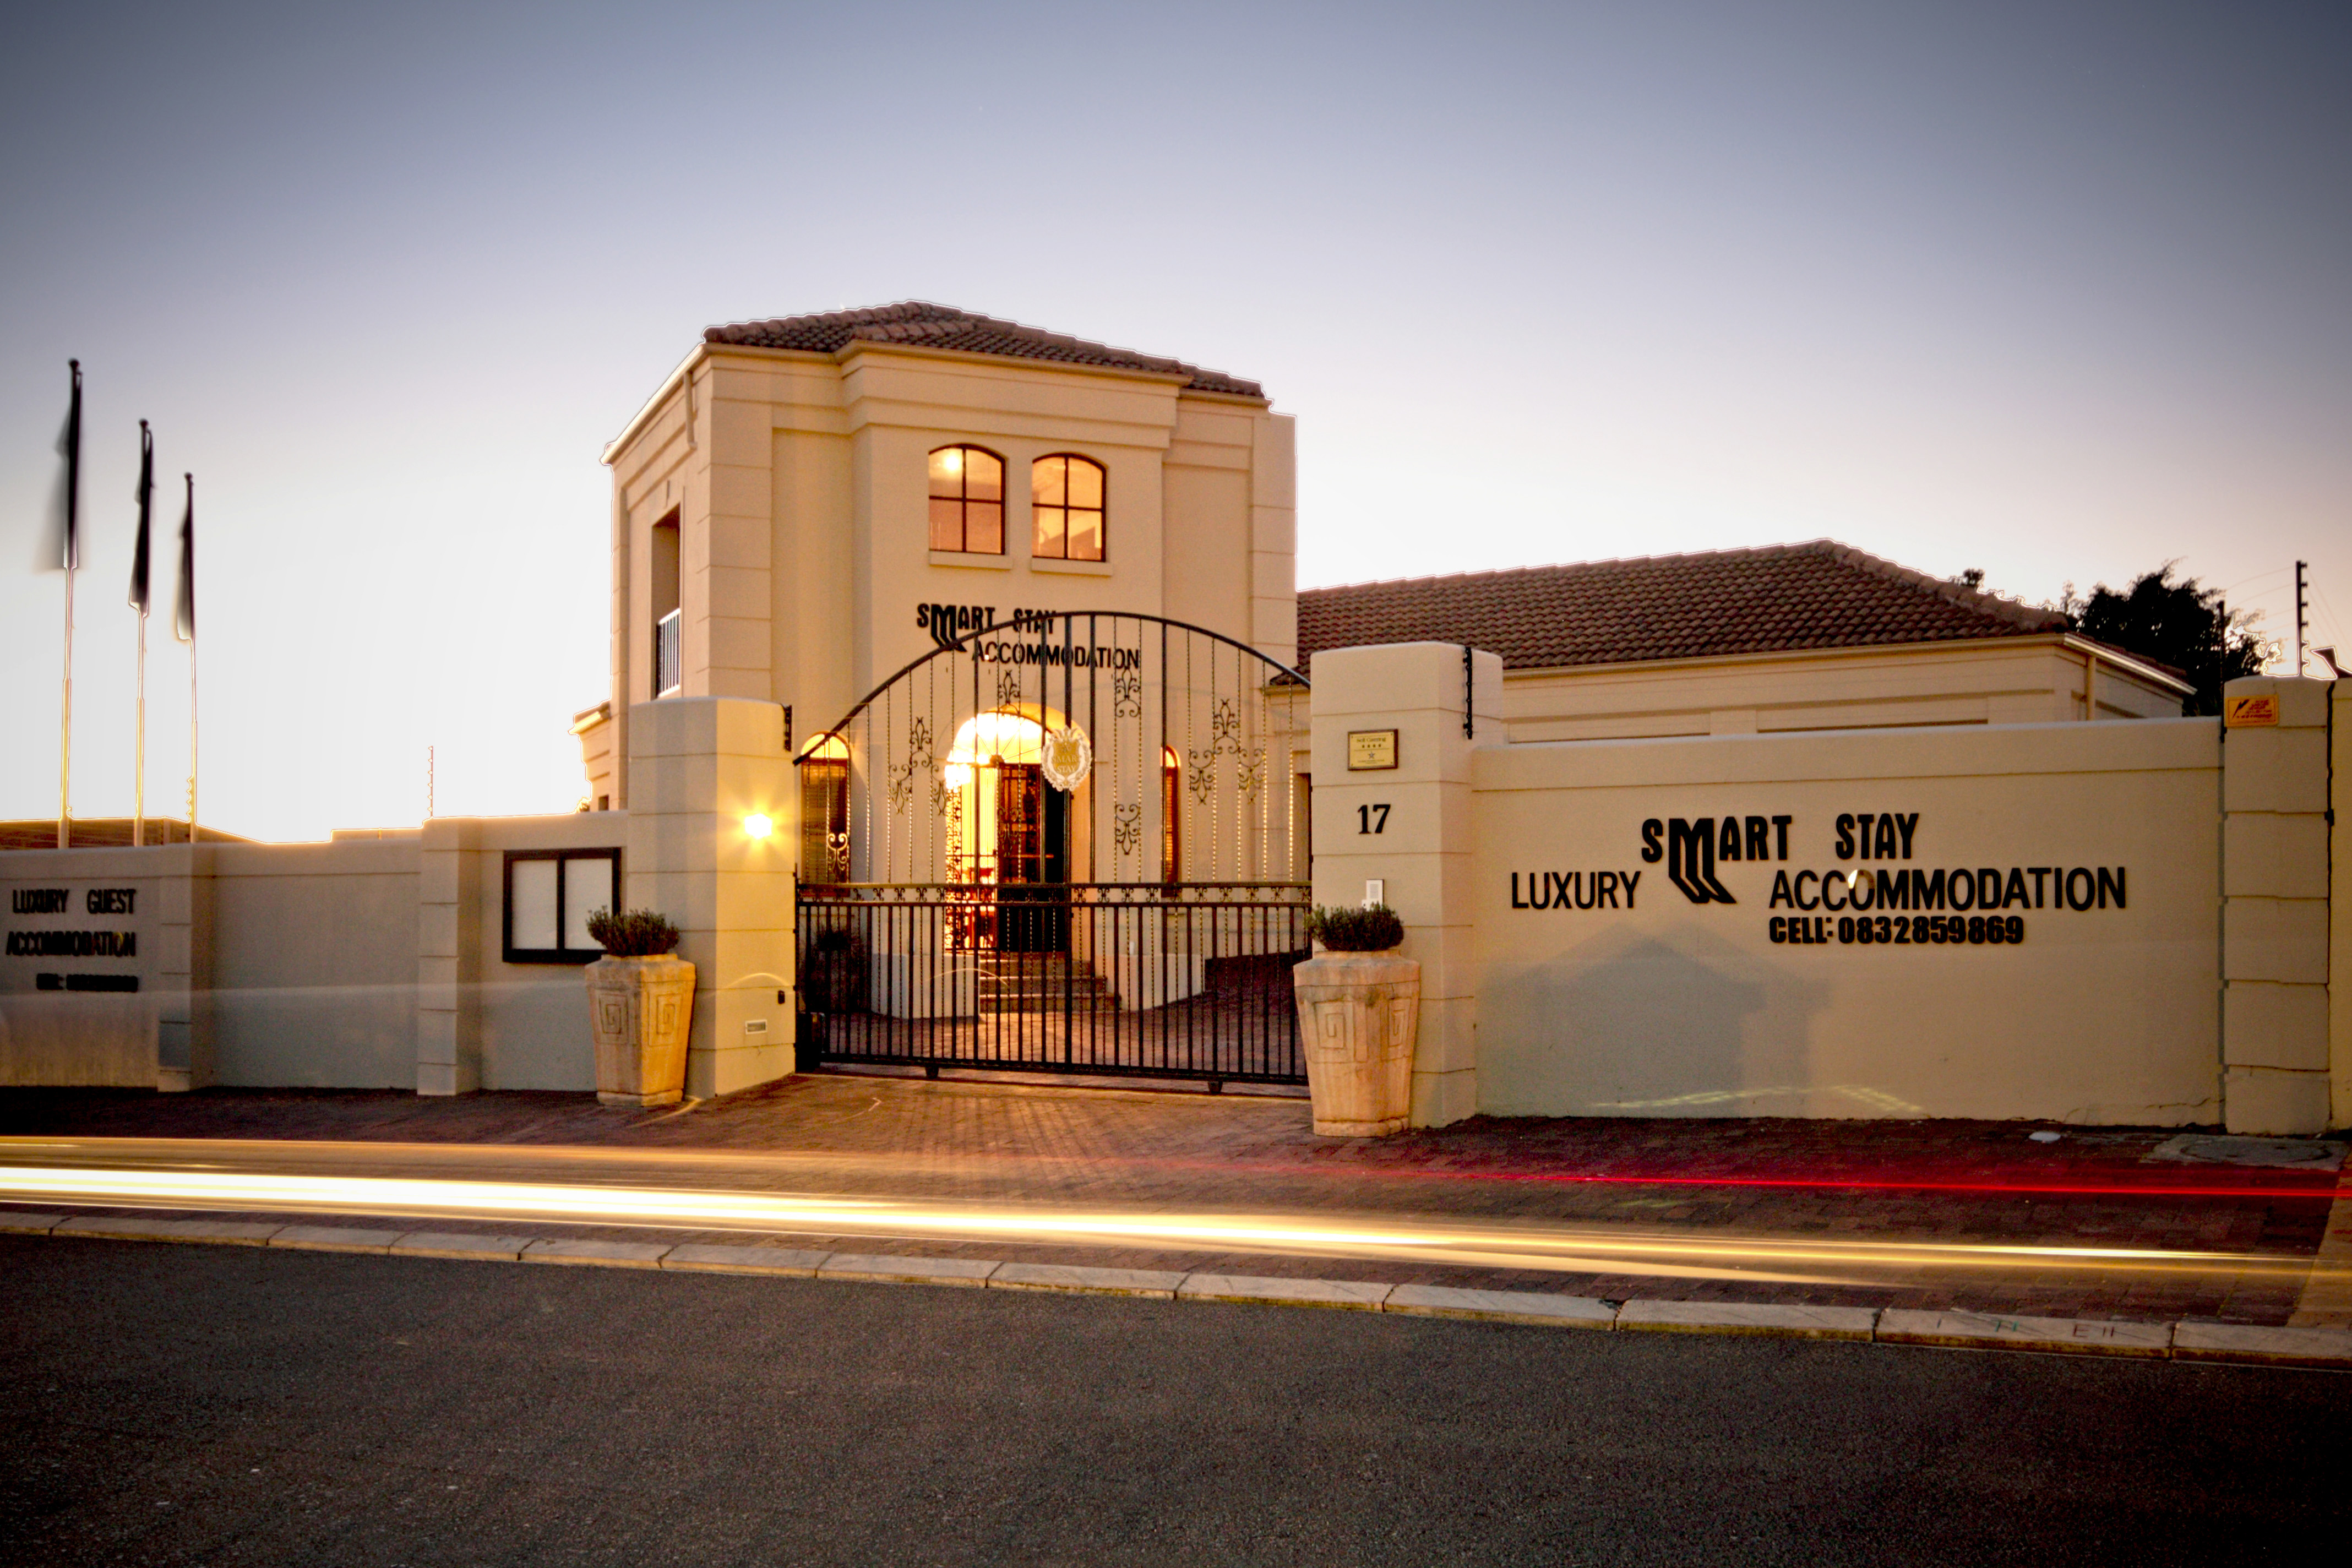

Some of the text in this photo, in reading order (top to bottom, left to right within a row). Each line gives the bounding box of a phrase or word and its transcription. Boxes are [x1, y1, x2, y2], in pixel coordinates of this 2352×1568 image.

[917, 603, 995, 653] SMART
[1357, 804, 1391, 835] 17
[1641, 813, 1919, 905] SMART STAY
[12, 888, 137, 914] LUXURY GUEST
[1511, 866, 2127, 912] LUXURY ACCOMMODATION
[1768, 915, 2025, 945] CELL: 0832859869
